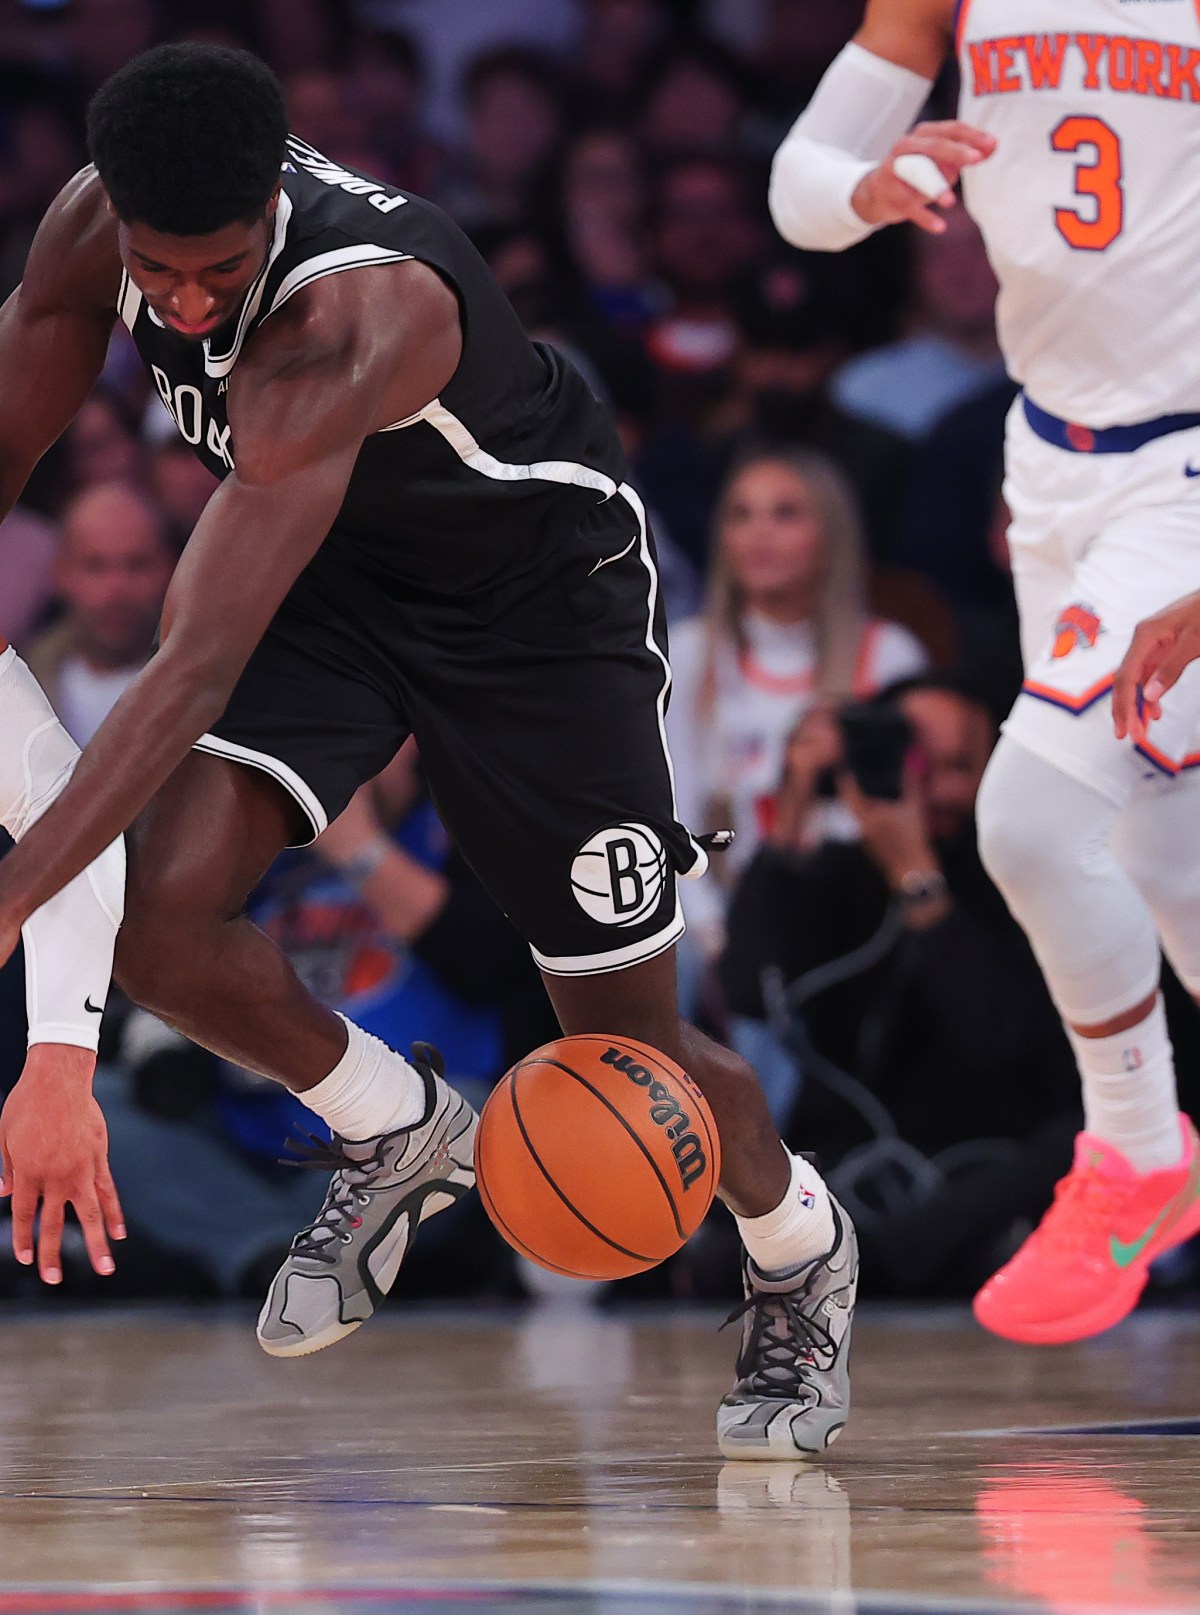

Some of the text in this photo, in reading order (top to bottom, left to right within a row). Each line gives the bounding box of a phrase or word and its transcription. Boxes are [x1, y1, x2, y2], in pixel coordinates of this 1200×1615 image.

[968, 32, 1200, 105] NEW YORK
[1050, 115, 1123, 252] 3
[605, 837, 645, 915] B
[599, 1046, 707, 1194] Wilson
